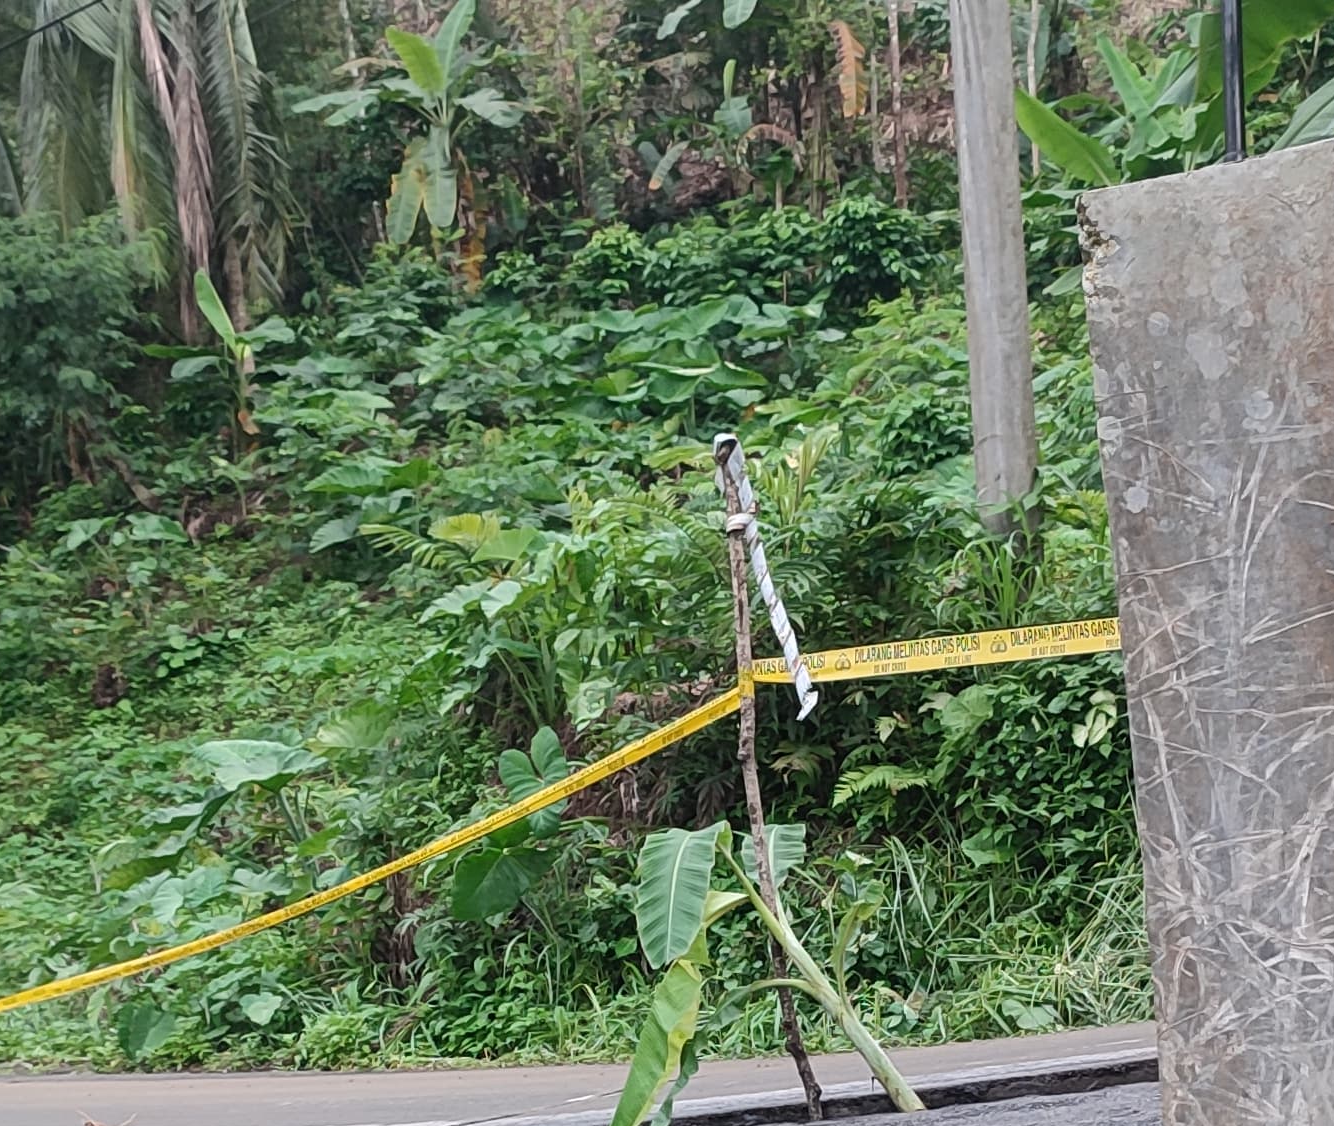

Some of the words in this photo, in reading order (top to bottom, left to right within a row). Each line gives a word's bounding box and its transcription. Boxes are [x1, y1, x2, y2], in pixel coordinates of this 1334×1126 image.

[1010, 627, 1050, 647] DILARANG
[1051, 623, 1090, 642] MELINTAS
[1091, 619, 1116, 638] GARIS
[854, 646, 892, 665] DILARANG
[893, 640, 930, 659] MELINTAS
[931, 637, 955, 655] GARIS
[956, 635, 981, 652] POLISI
